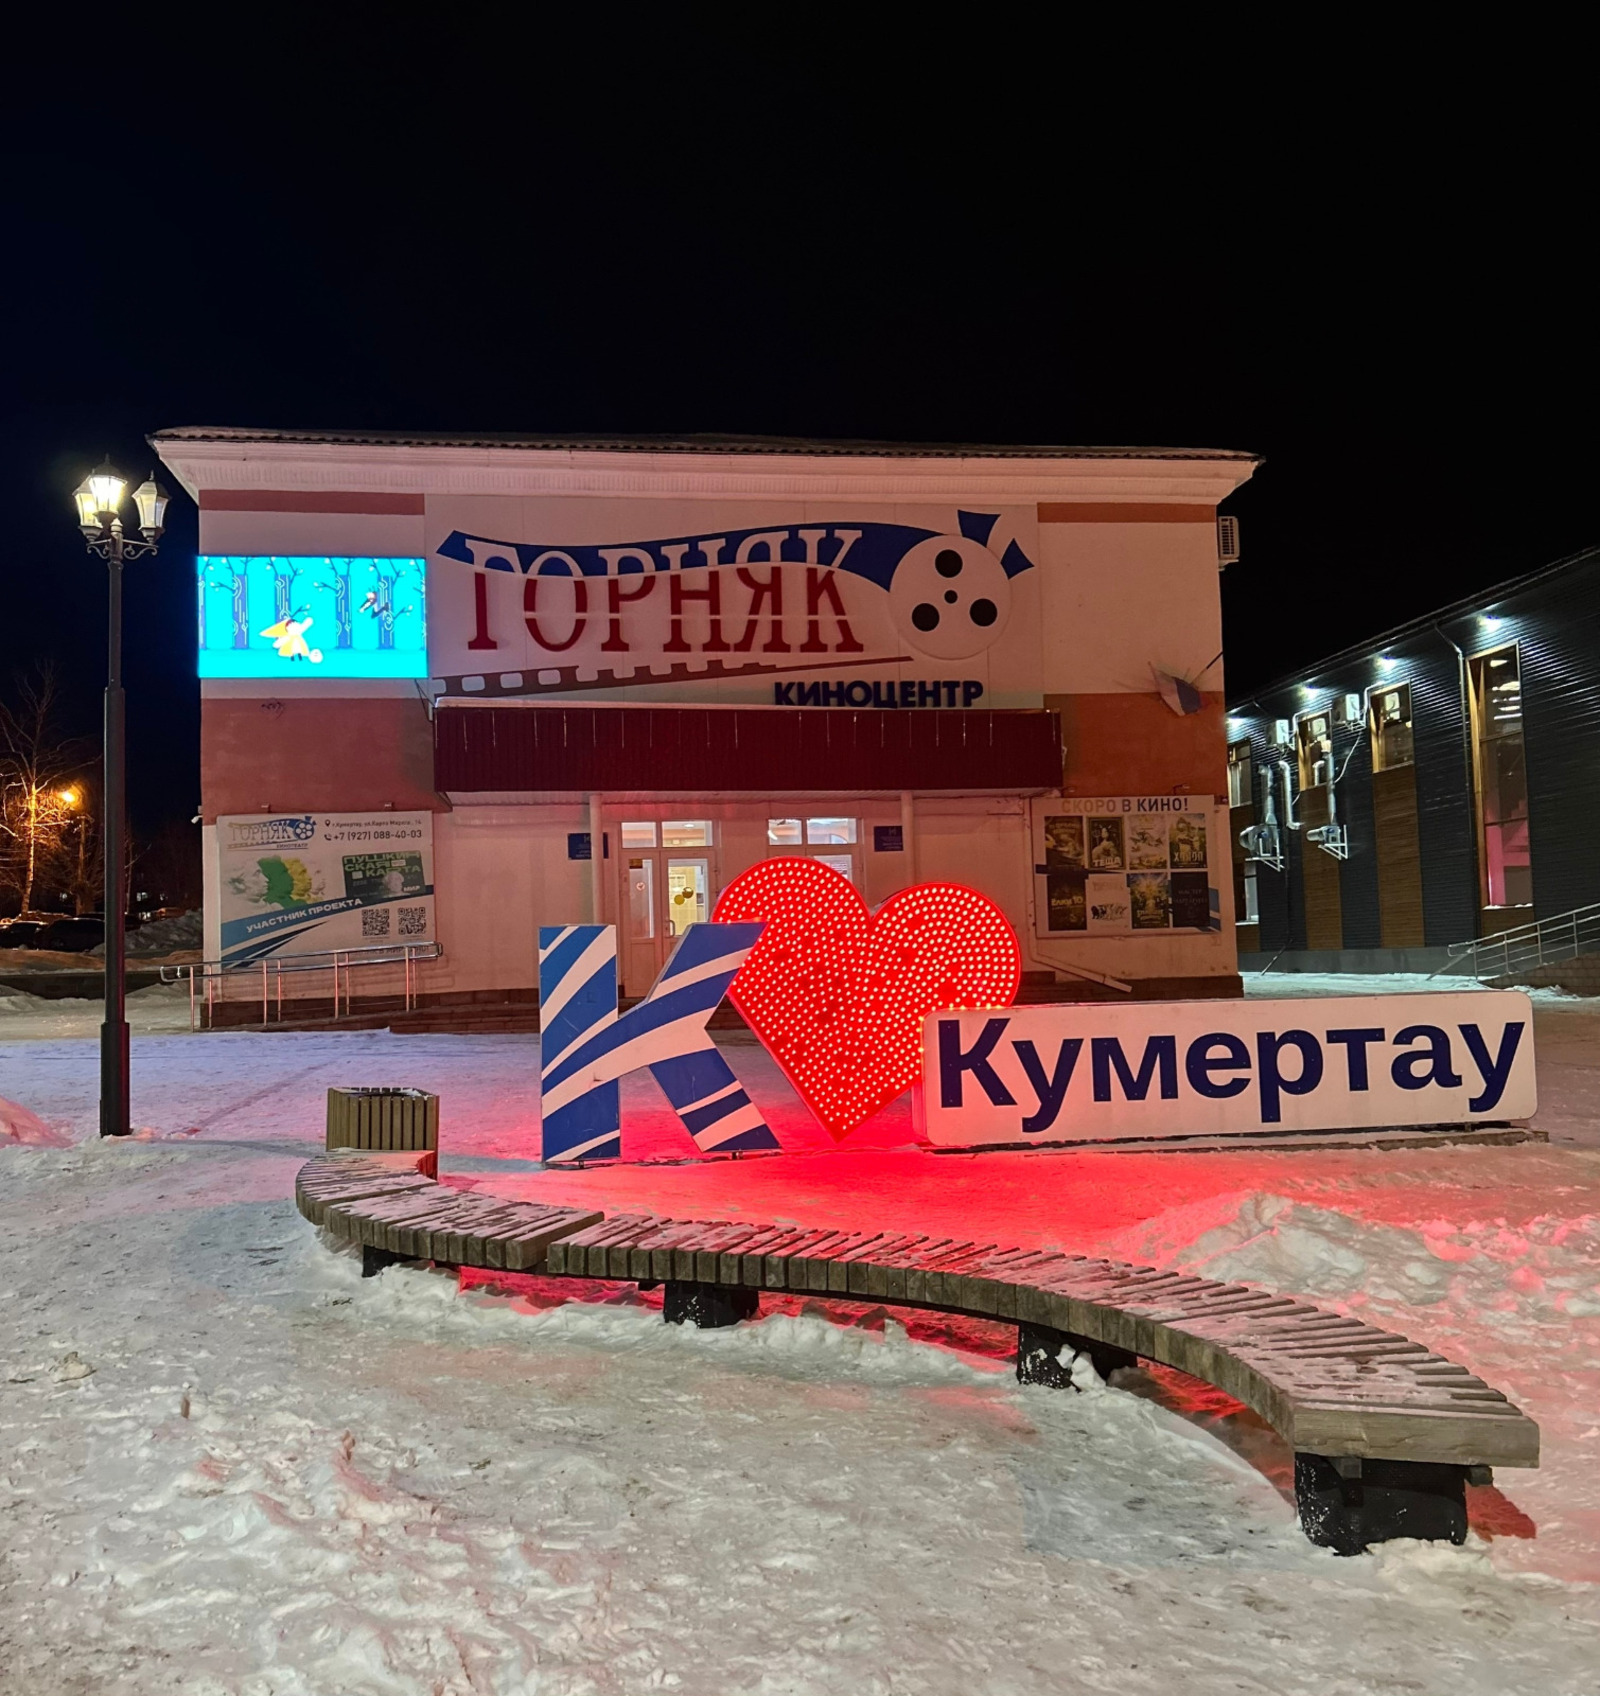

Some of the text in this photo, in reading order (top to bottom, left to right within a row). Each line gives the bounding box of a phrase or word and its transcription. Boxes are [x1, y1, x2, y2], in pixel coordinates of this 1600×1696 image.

[465, 528, 865, 654] ГОРНЯК
[774, 680, 984, 709] КИНОЦЕНТР
[1061, 797, 1188, 813] СКОРО В КИНО!
[231, 820, 291, 841] ГОРНЯК
[333, 829, 422, 841] +7 (927) 088-40-03
[344, 860, 391, 872] СКАЯ
[246, 898, 363, 933] УЧАСТНИК ПРОЕКТА
[937, 1017, 1526, 1133] Кумертау
